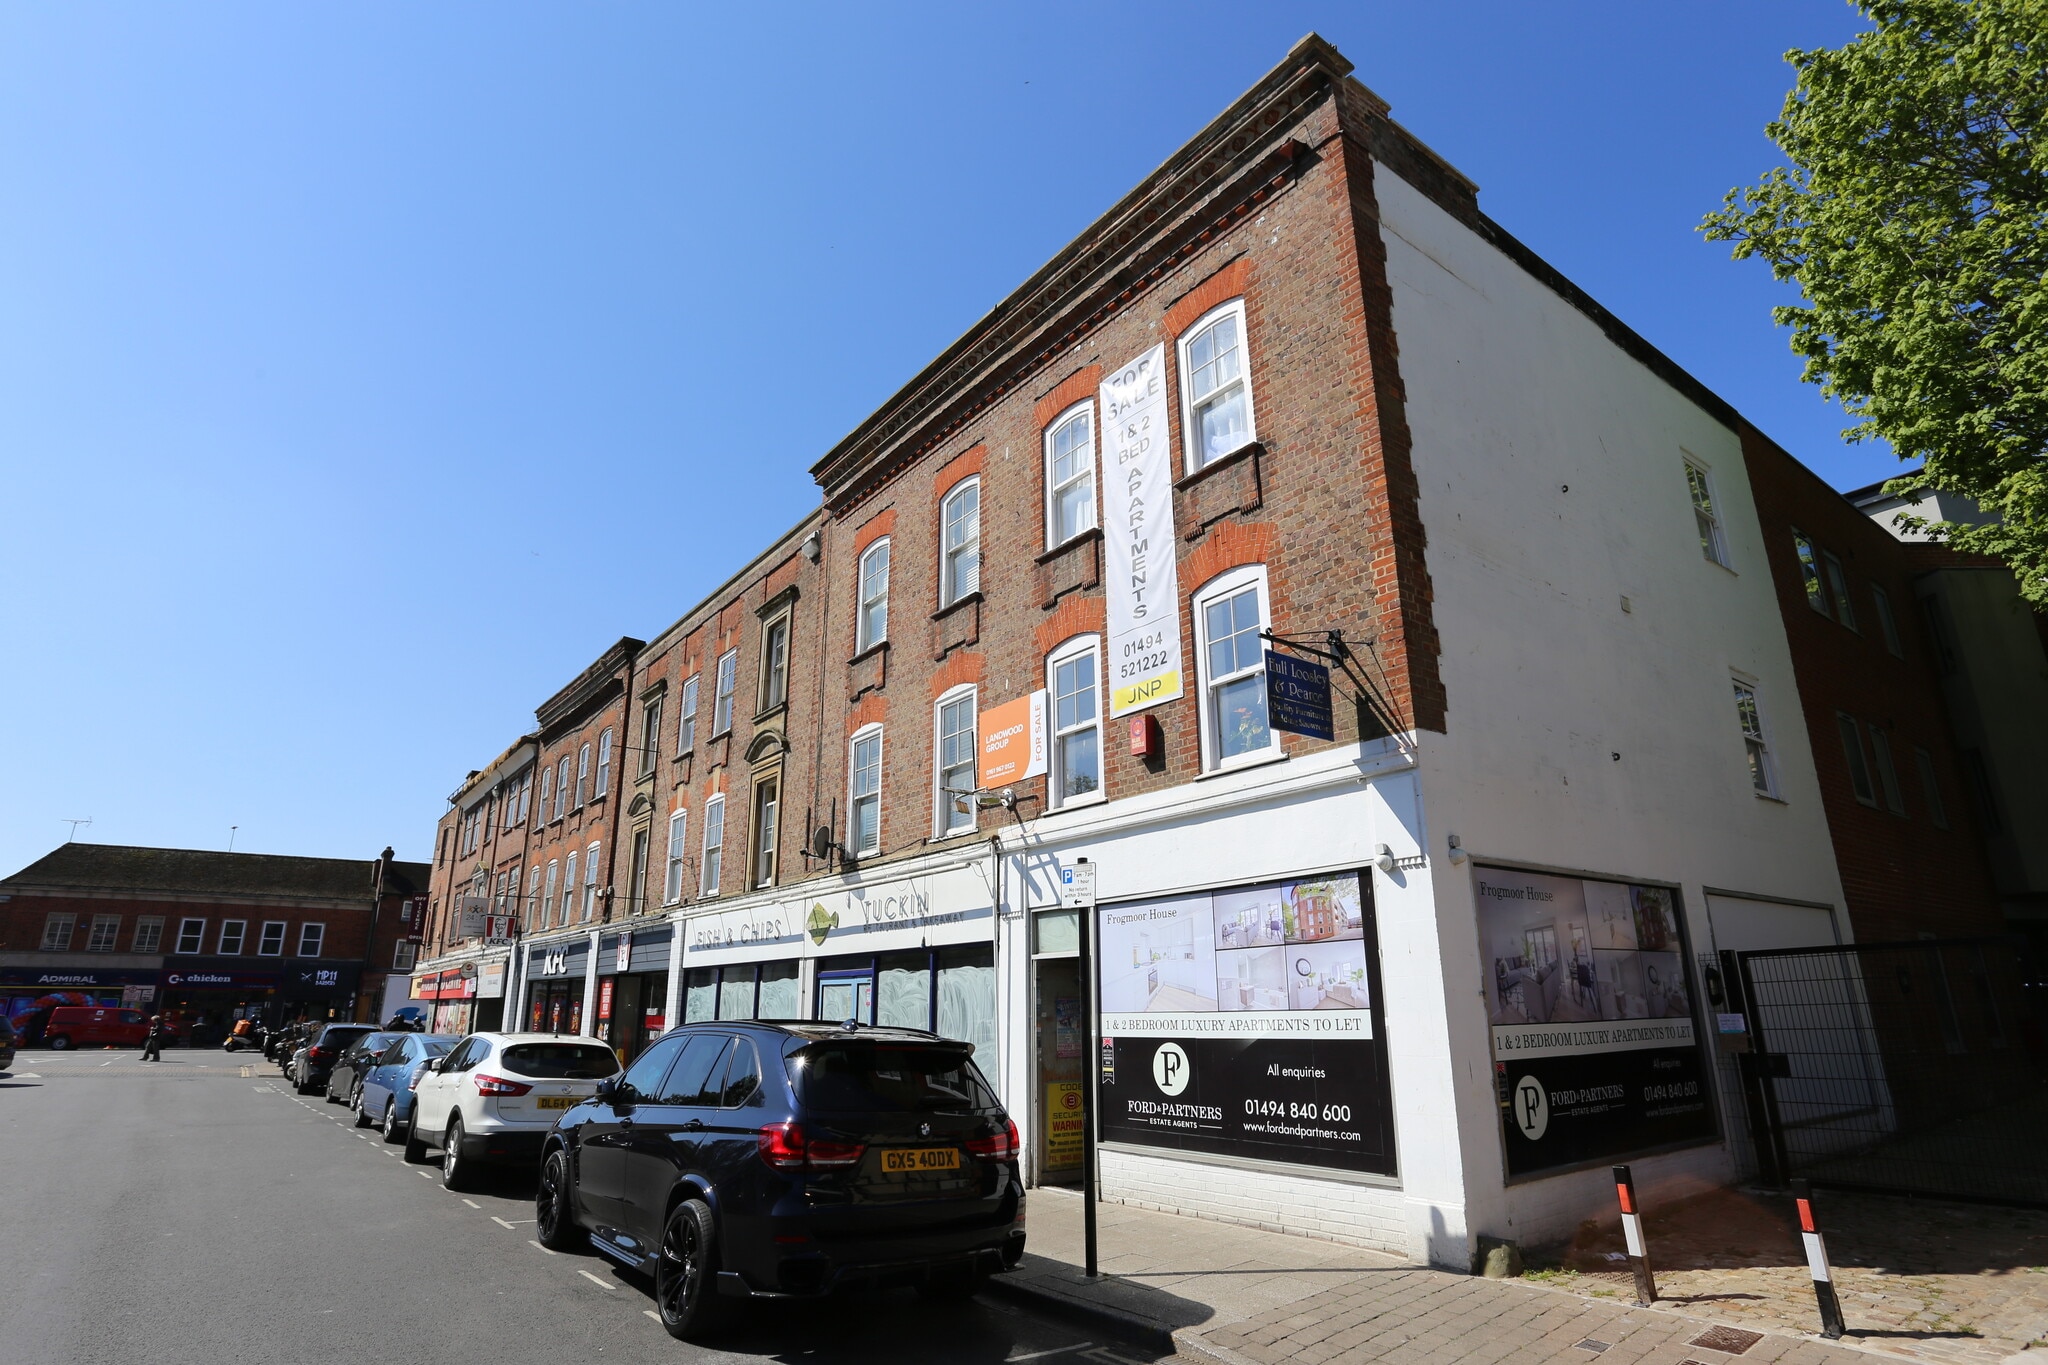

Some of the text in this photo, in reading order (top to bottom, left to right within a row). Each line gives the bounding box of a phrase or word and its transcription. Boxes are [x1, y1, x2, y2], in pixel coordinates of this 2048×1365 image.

[1111, 359, 1150, 397] FOR
[1107, 376, 1160, 421] SALE
[1118, 415, 1150, 443] 1 & 2
[1119, 437, 1150, 465] BED
[1127, 466, 1149, 619] APARTMENTS
[1124, 631, 1163, 657] 01494
[1121, 650, 1168, 678] 521222
[1128, 679, 1162, 704] JNP
[1274, 680, 1324, 703] & Pearce
[1034, 704, 1042, 734] SALE
[985, 723, 1024, 744] LANDWOOD
[985, 738, 1009, 753] GROUP
[1480, 881, 1553, 902] Frogmoor House
[863, 919, 908, 934] RETAURANT
[920, 912, 965, 927] TAKEAWAY
[1107, 909, 1177, 926] Frogmoor House
[488, 937, 509, 945] KFC
[696, 919, 782, 949] FISH & CHIPS
[542, 940, 569, 976] KFC
[38, 974, 97, 984] ADMIRAL
[187, 974, 231, 983] chicken
[316, 970, 338, 981] HP11
[1106, 1018, 1361, 1031] 1 & 2 BEDROOM LUXURY APARTMENTS TO LET
[1497, 1025, 1691, 1050] 1 & 2 BEDROOM LUXURY APARTMENTS TO LET
[1267, 1063, 1326, 1080] All enquiries
[1060, 1083, 1083, 1091] CODE
[1644, 1080, 1698, 1102] 01494 840 600
[1068, 1096, 1075, 1106] 3
[1245, 1099, 1351, 1122] 01494 840 600
[1571, 1104, 1609, 1116] ESTATE AGENTS
[1053, 1111, 1083, 1119] SECURI
[1053, 1119, 1083, 1132] WARNIN
[1149, 1117, 1197, 1129] ESTATE AGENTS
[1243, 1120, 1361, 1141] www.fordandpartners.com
